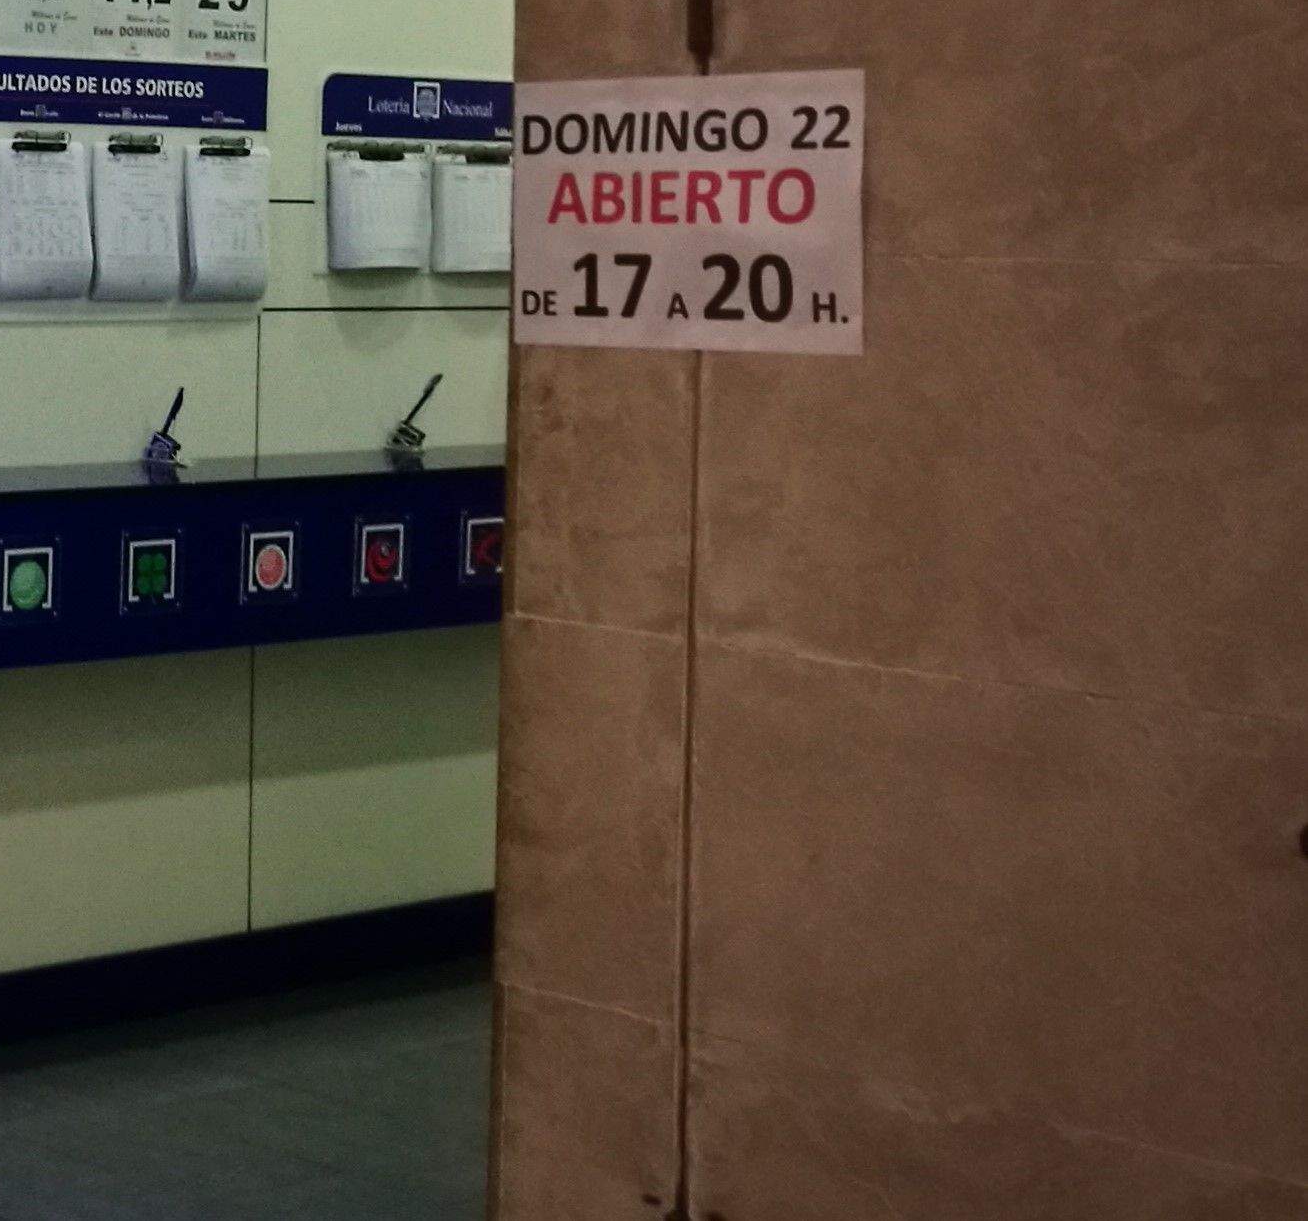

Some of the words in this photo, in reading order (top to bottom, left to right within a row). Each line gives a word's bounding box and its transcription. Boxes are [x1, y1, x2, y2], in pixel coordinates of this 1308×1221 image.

[119, 26, 171, 39] DOMINGO
[214, 30, 257, 43] MARTES
[76, 76, 98, 94] DE
[102, 77, 132, 96] LOS
[135, 78, 205, 99] SORTEOS
[443, 99, 494, 118] Nacional
[522, 108, 769, 156] DOMINGO
[791, 105, 851, 150] 22
[546, 168, 816, 225] ABIERTO
[522, 290, 558, 316] DE
[573, 253, 652, 319] 17
[667, 293, 689, 320] A
[702, 253, 794, 323] 20
[812, 292, 850, 324] H.
